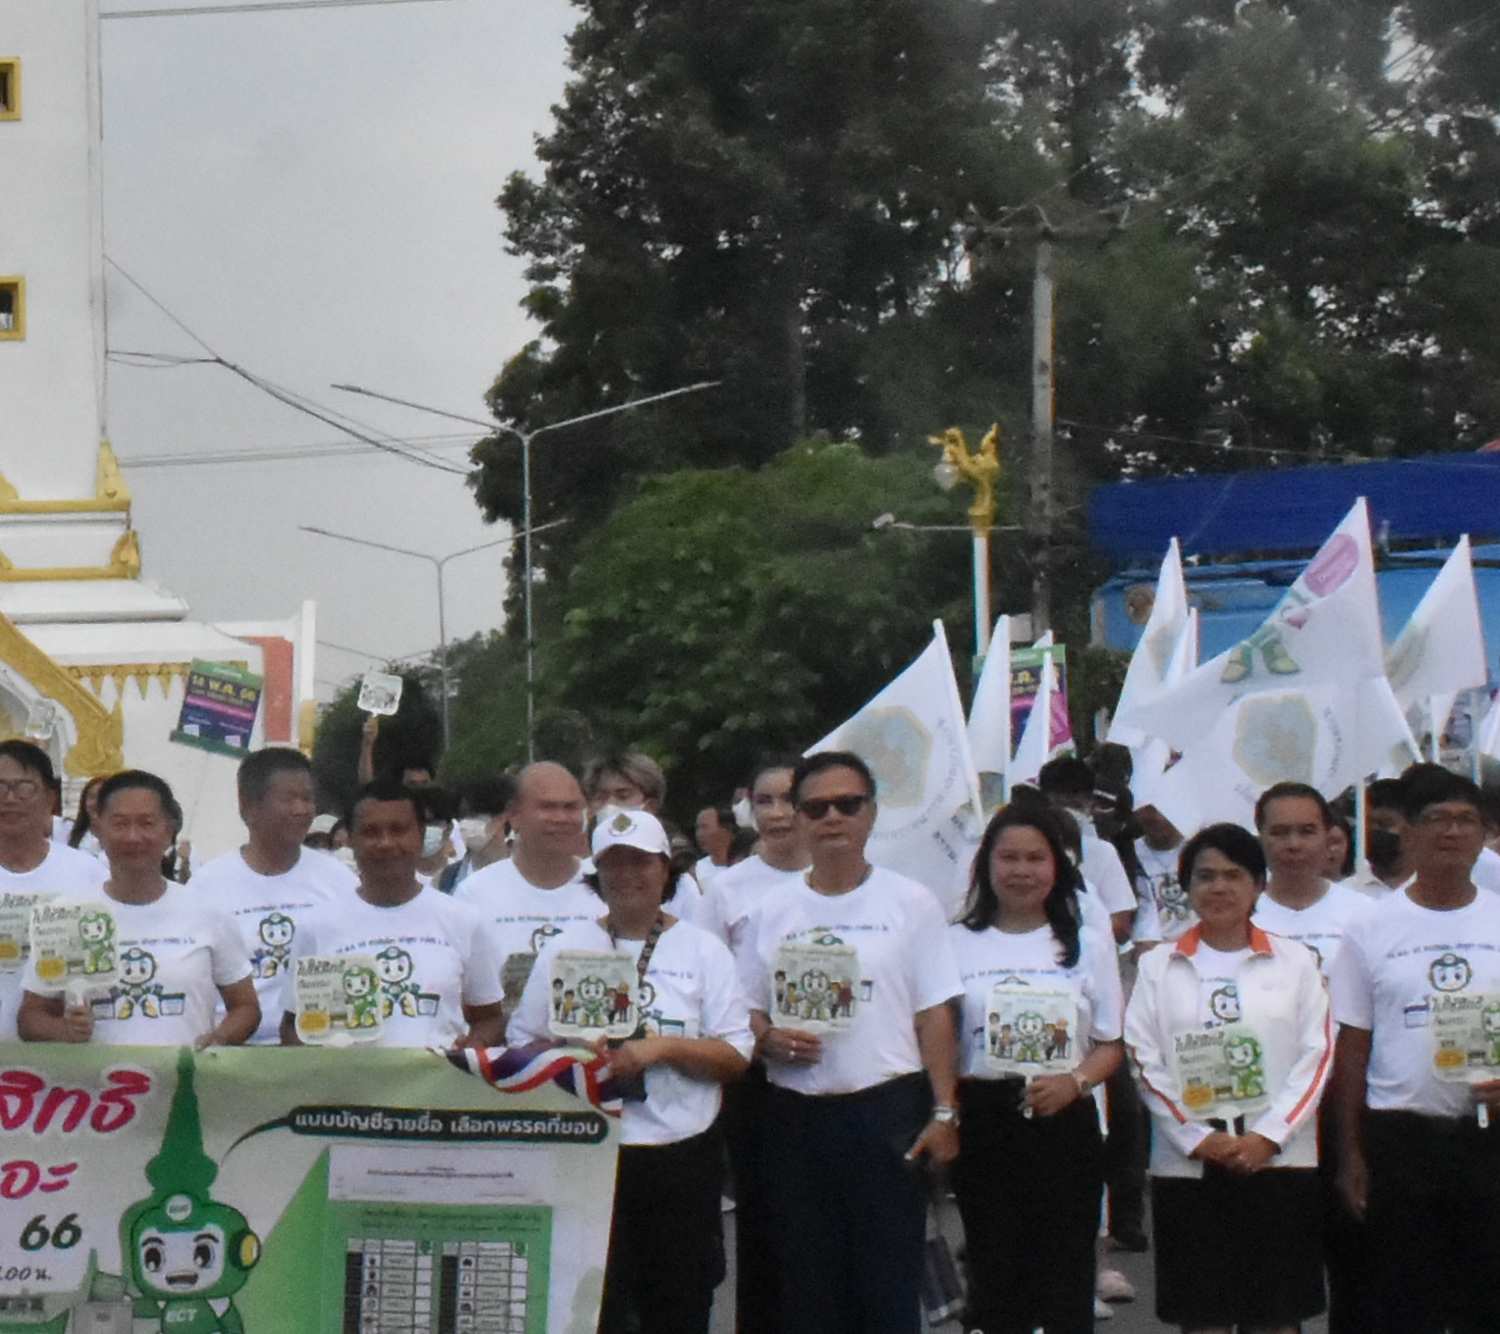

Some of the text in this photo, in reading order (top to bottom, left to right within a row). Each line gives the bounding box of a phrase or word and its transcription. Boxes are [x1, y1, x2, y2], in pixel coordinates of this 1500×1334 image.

[295, 1110, 444, 1134] แบบบัญชีรายชื่อ
[18, 1213, 83, 1251] 66
[165, 1308, 198, 1323] ECT
